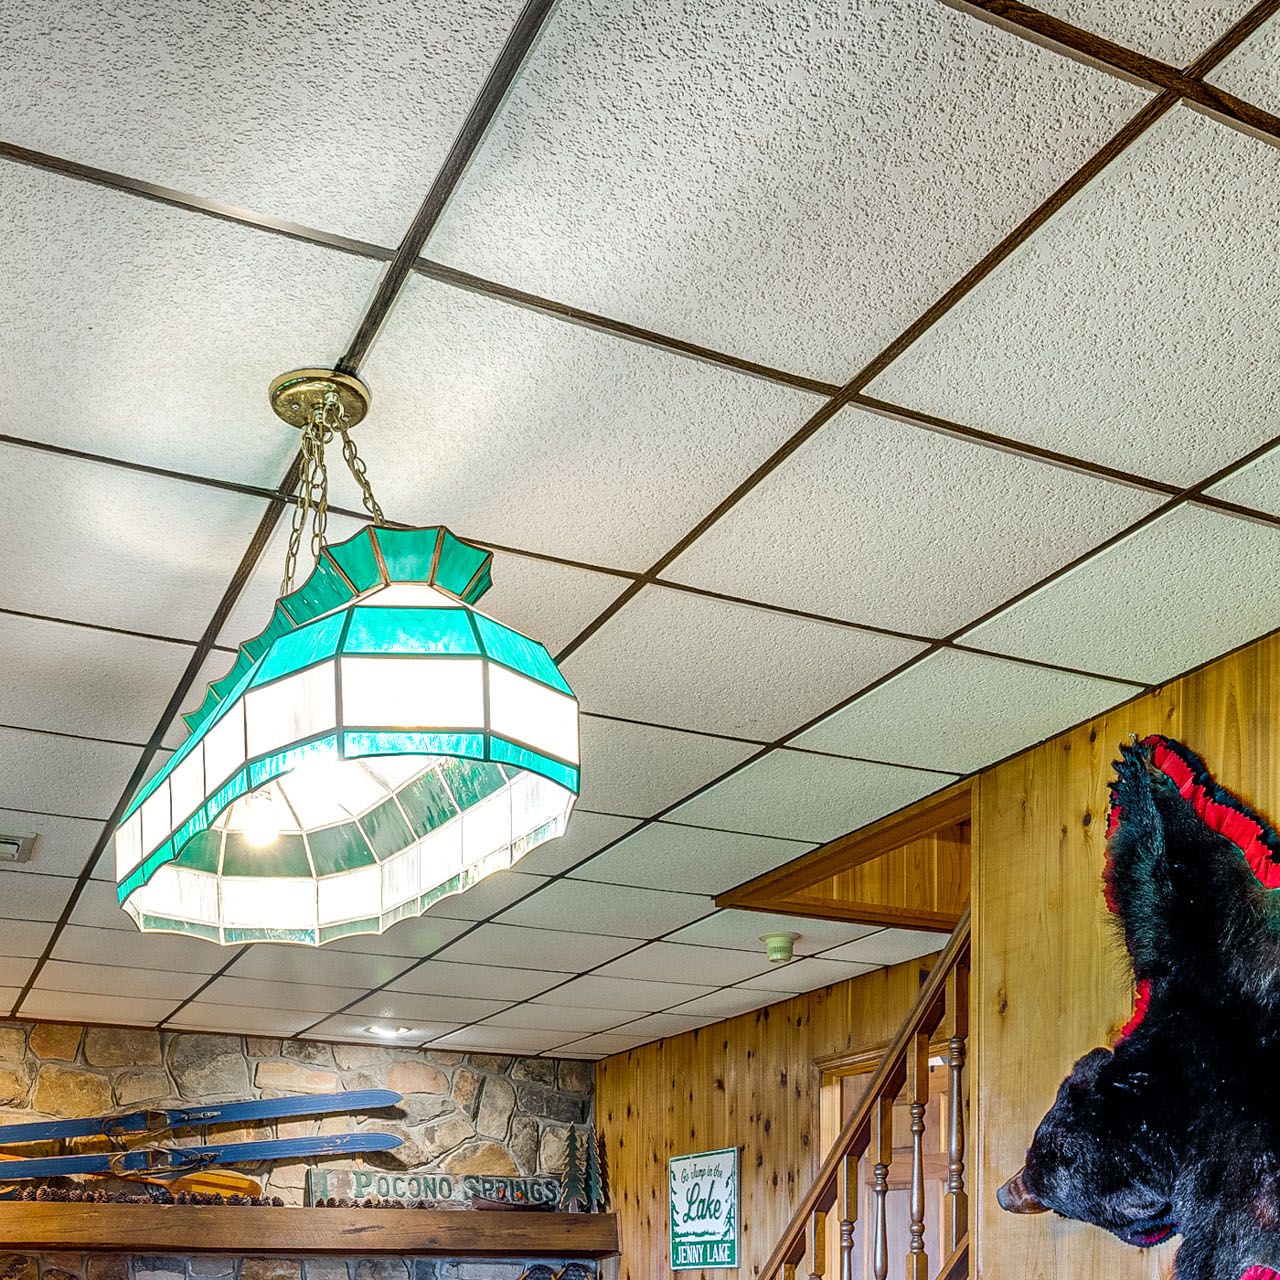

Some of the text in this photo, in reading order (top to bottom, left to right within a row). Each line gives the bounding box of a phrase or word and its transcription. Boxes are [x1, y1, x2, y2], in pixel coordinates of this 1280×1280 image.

[352, 1170, 453, 1200] POCONO
[463, 1173, 559, 1203] SPRINGS
[683, 1179, 722, 1223] Lake
[677, 1243, 731, 1263] JENNY LAKE
